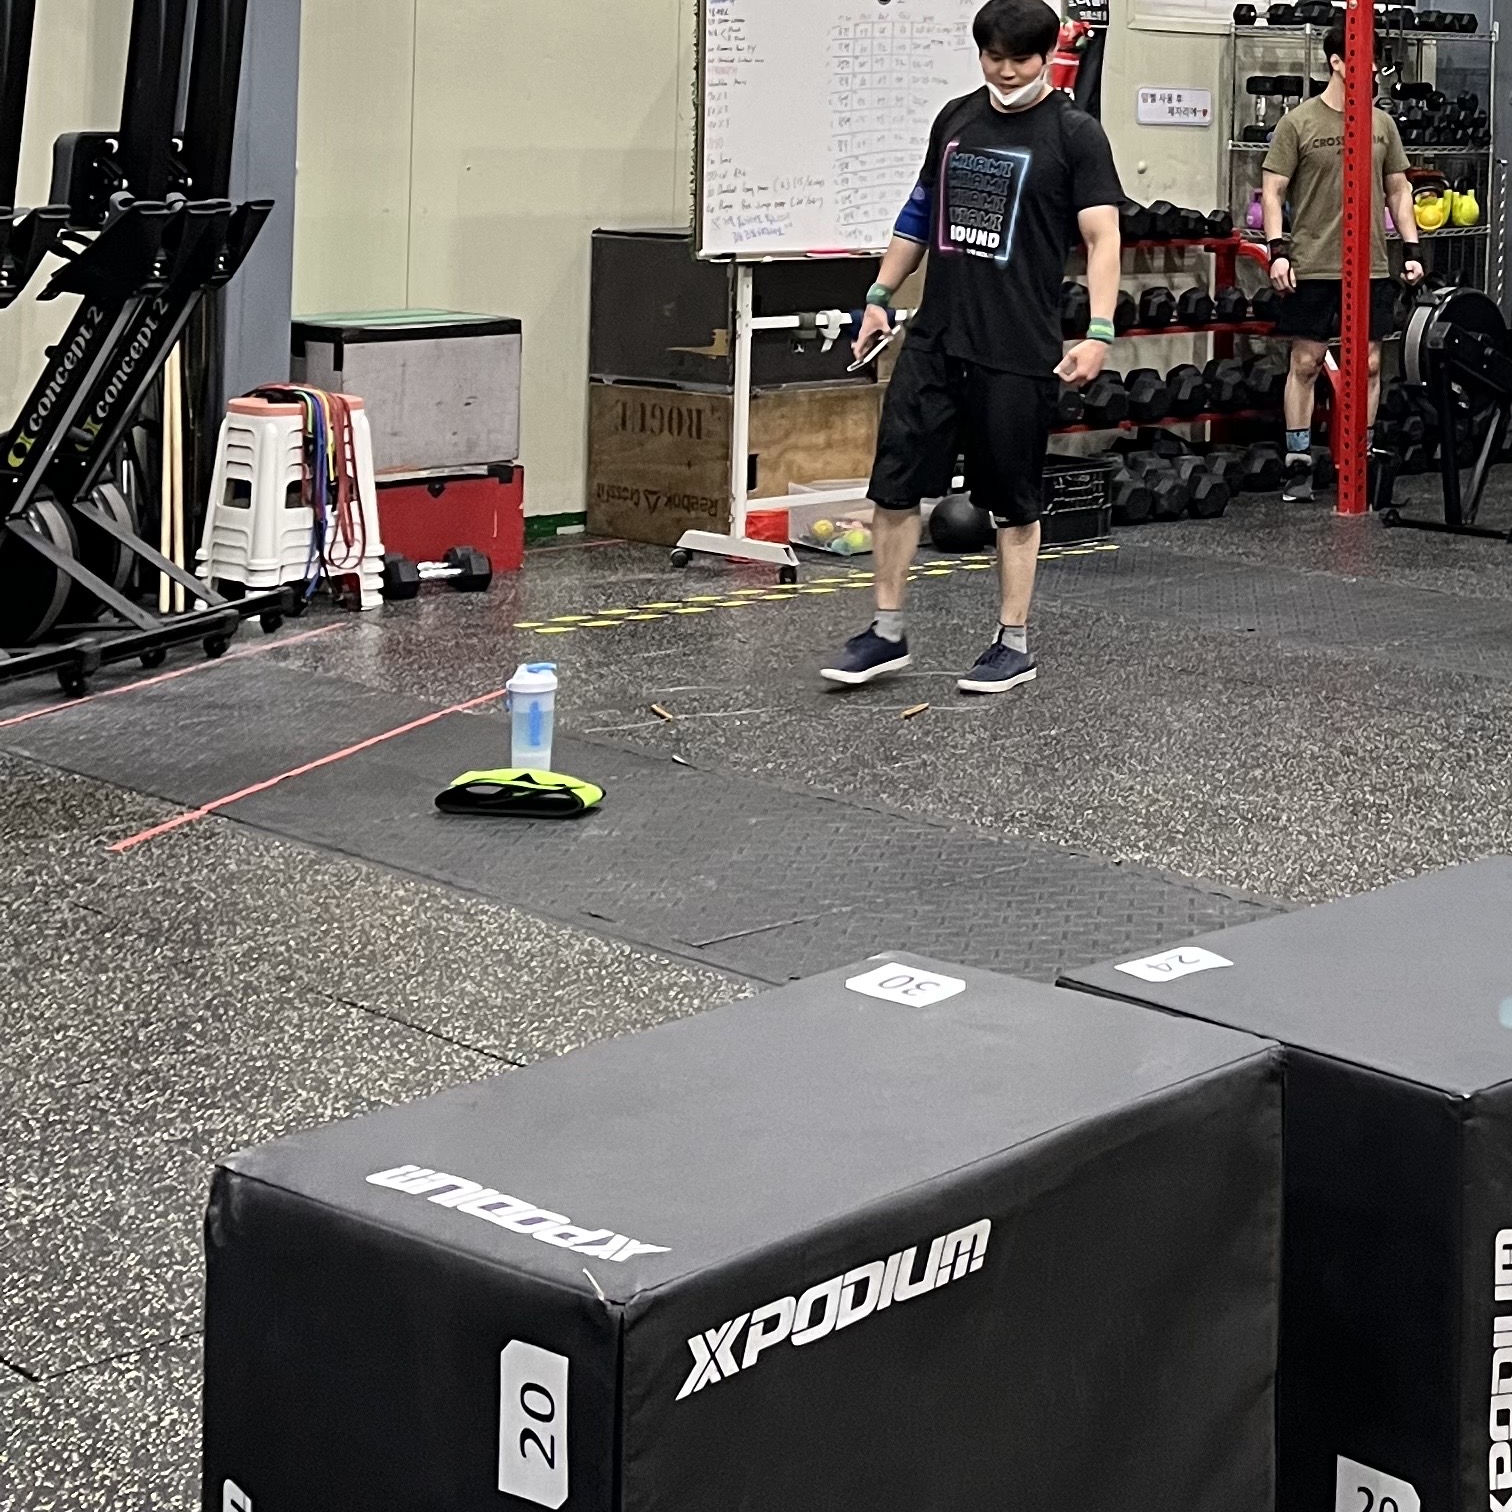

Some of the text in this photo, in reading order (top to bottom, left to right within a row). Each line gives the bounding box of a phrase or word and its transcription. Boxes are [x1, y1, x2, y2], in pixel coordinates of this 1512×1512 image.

[949, 152, 1014, 178] MIAMI
[29, 306, 103, 431] concept 2
[96, 297, 169, 418] concept 2
[614, 400, 703, 439] ROGUE
[676, 1218, 992, 1401] XPODIUM
[519, 1382, 556, 1470] 20
